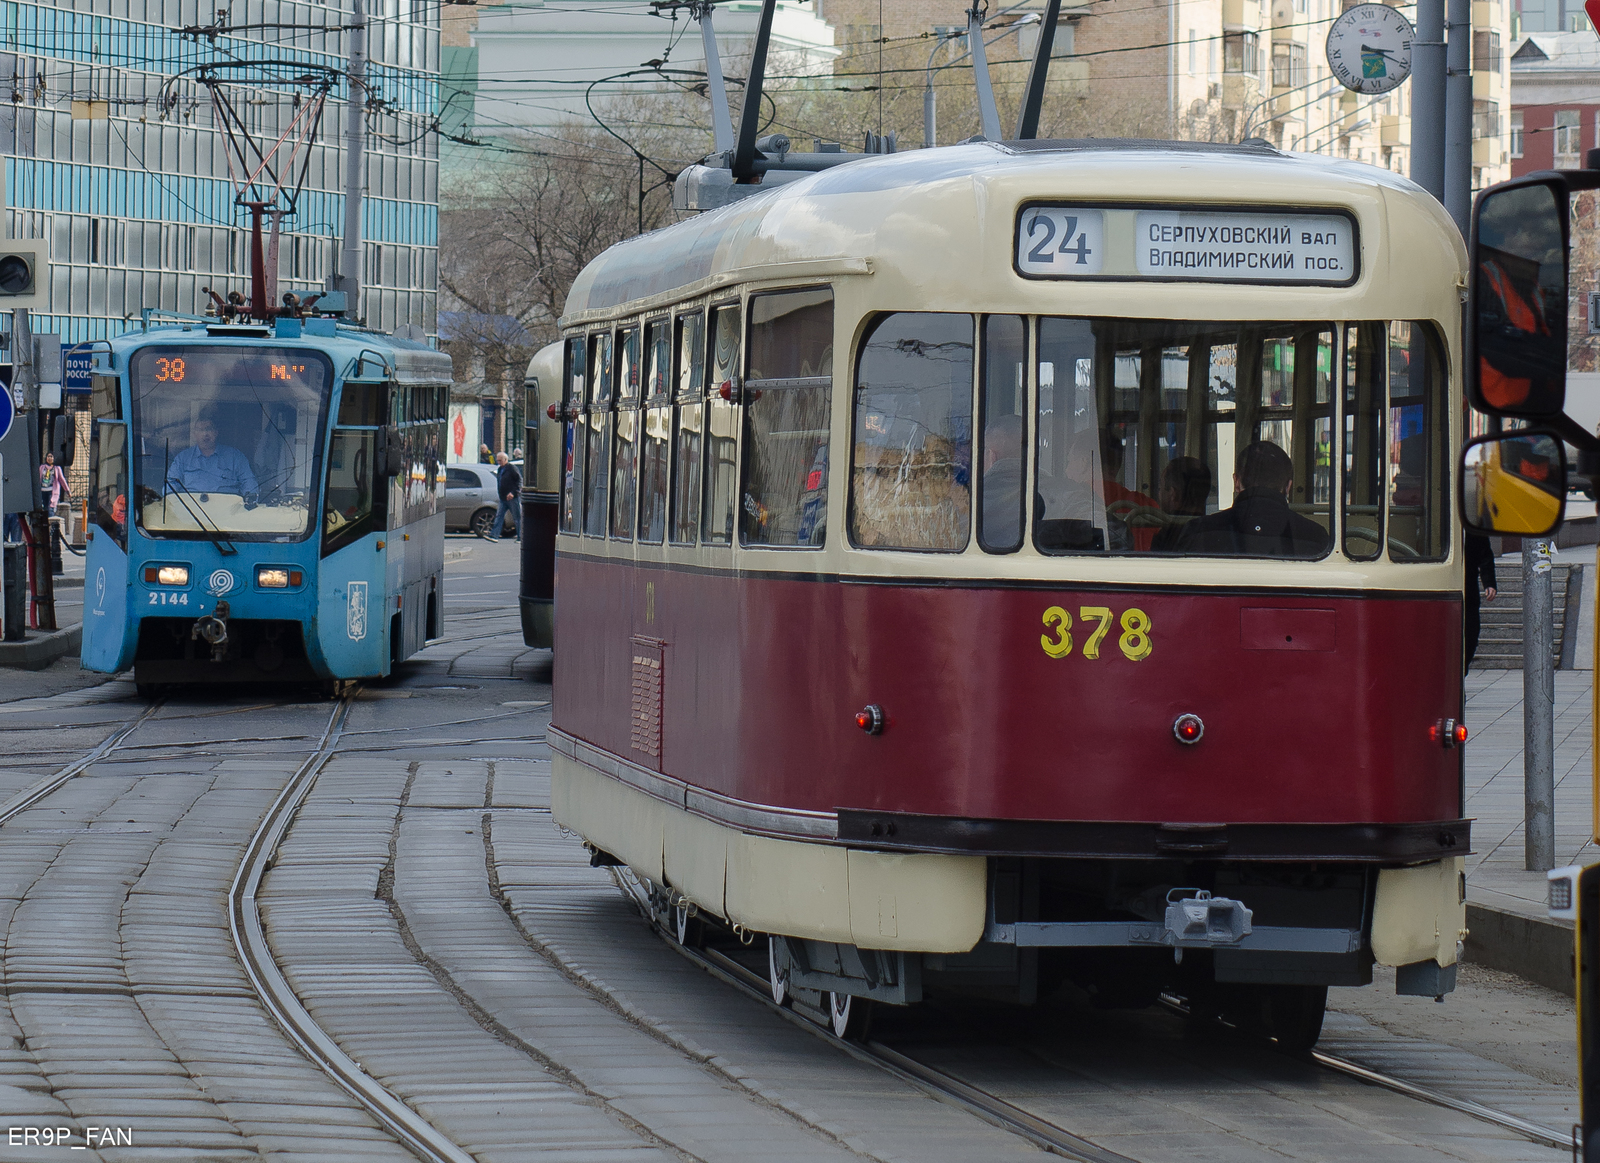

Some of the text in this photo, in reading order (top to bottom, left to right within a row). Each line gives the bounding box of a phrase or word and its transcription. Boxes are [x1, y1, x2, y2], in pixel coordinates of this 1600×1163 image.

[1361, 11, 1375, 19] XII
[1395, 25, 1404, 33] II
[1402, 41, 1411, 50] III
[1337, 62, 1350, 78] VIII
[1371, 80, 1381, 88] VI
[1027, 215, 1092, 264] 24
[1149, 223, 1337, 245] СЕРПУХОВСКИЙ ВАЛ
[1149, 248, 1344, 270] ВЛАДИМИРСКИЙ ПОС.
[155, 357, 185, 382] 38
[149, 592, 188, 605] 2144
[1040, 605, 1153, 661] 378
